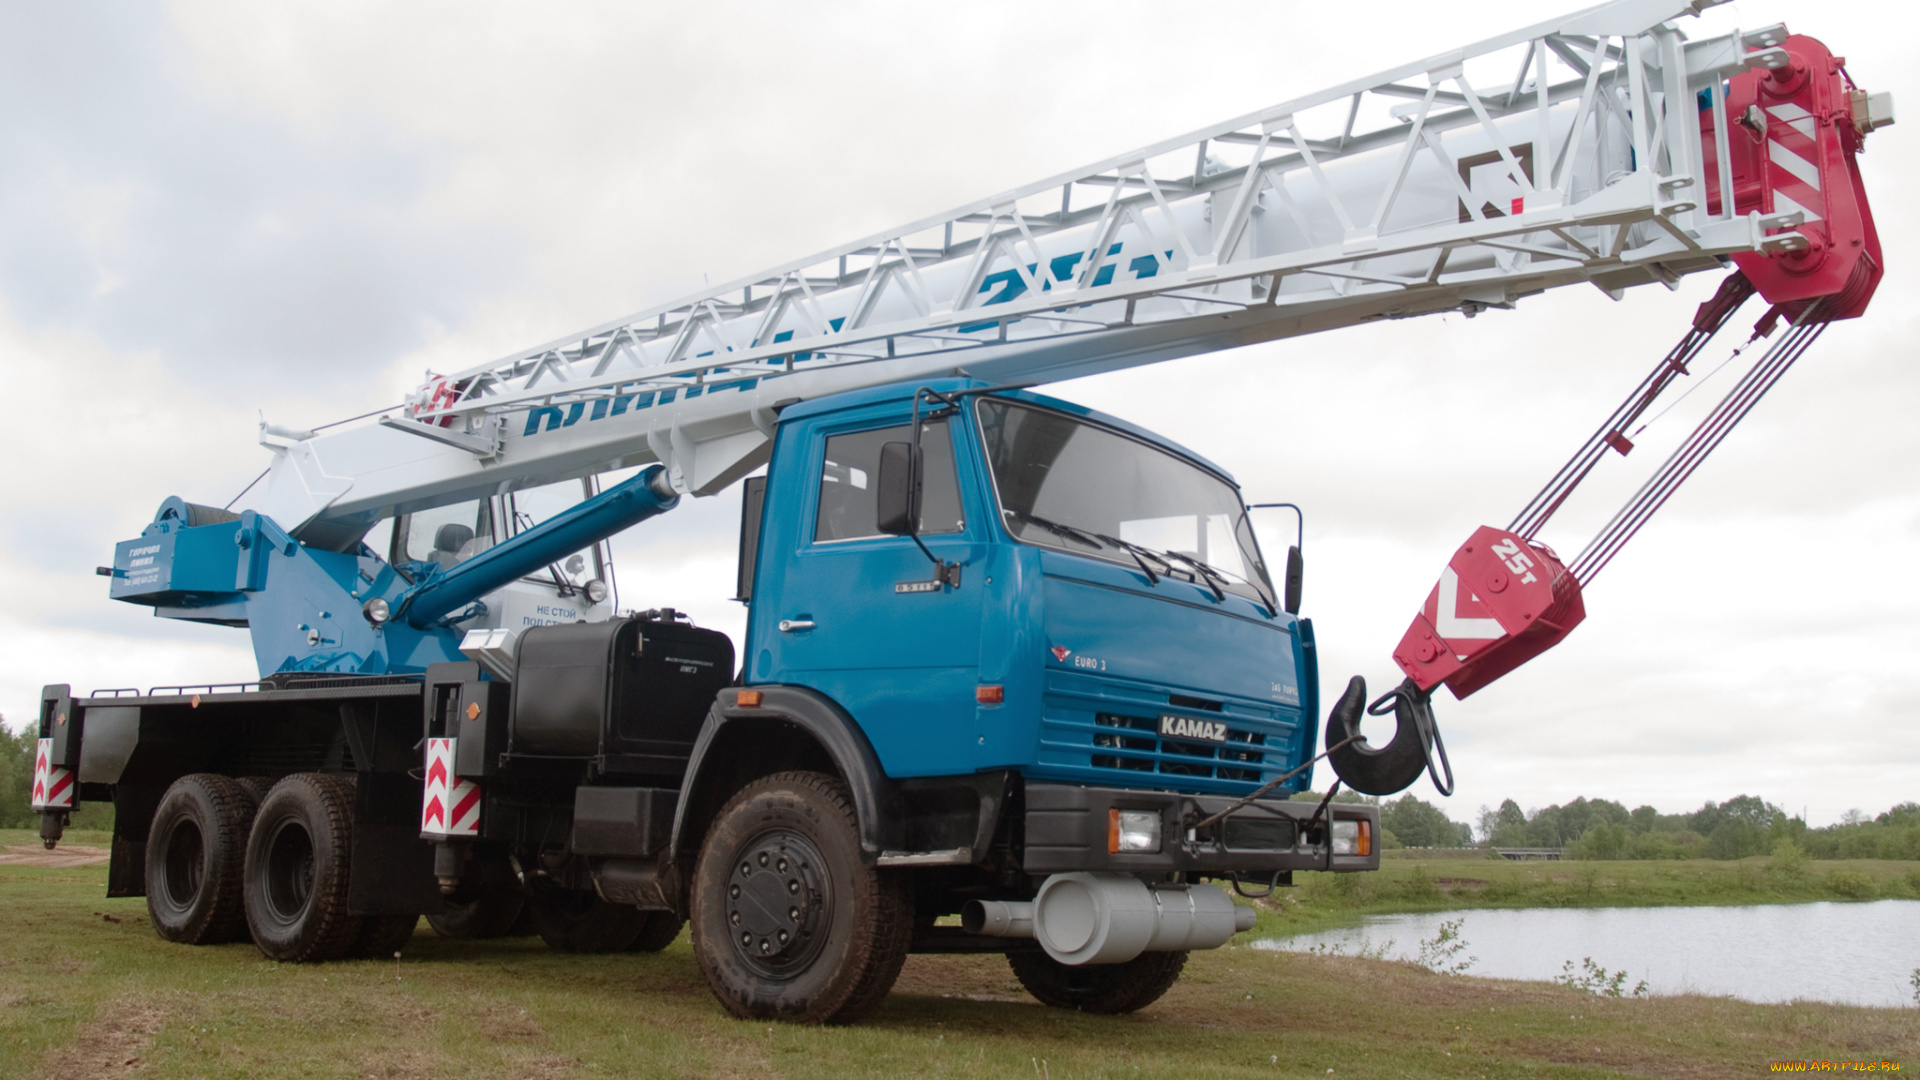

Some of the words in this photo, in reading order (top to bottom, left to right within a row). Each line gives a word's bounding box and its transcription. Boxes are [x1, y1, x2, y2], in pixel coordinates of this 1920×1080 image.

[537, 605, 550, 615] НЕ
[551, 607, 576, 619] СТОЙ
[1075, 655, 1097, 669] EURO
[1101, 659, 1106, 670] 3
[1162, 716, 1226, 741] KAMAZ
